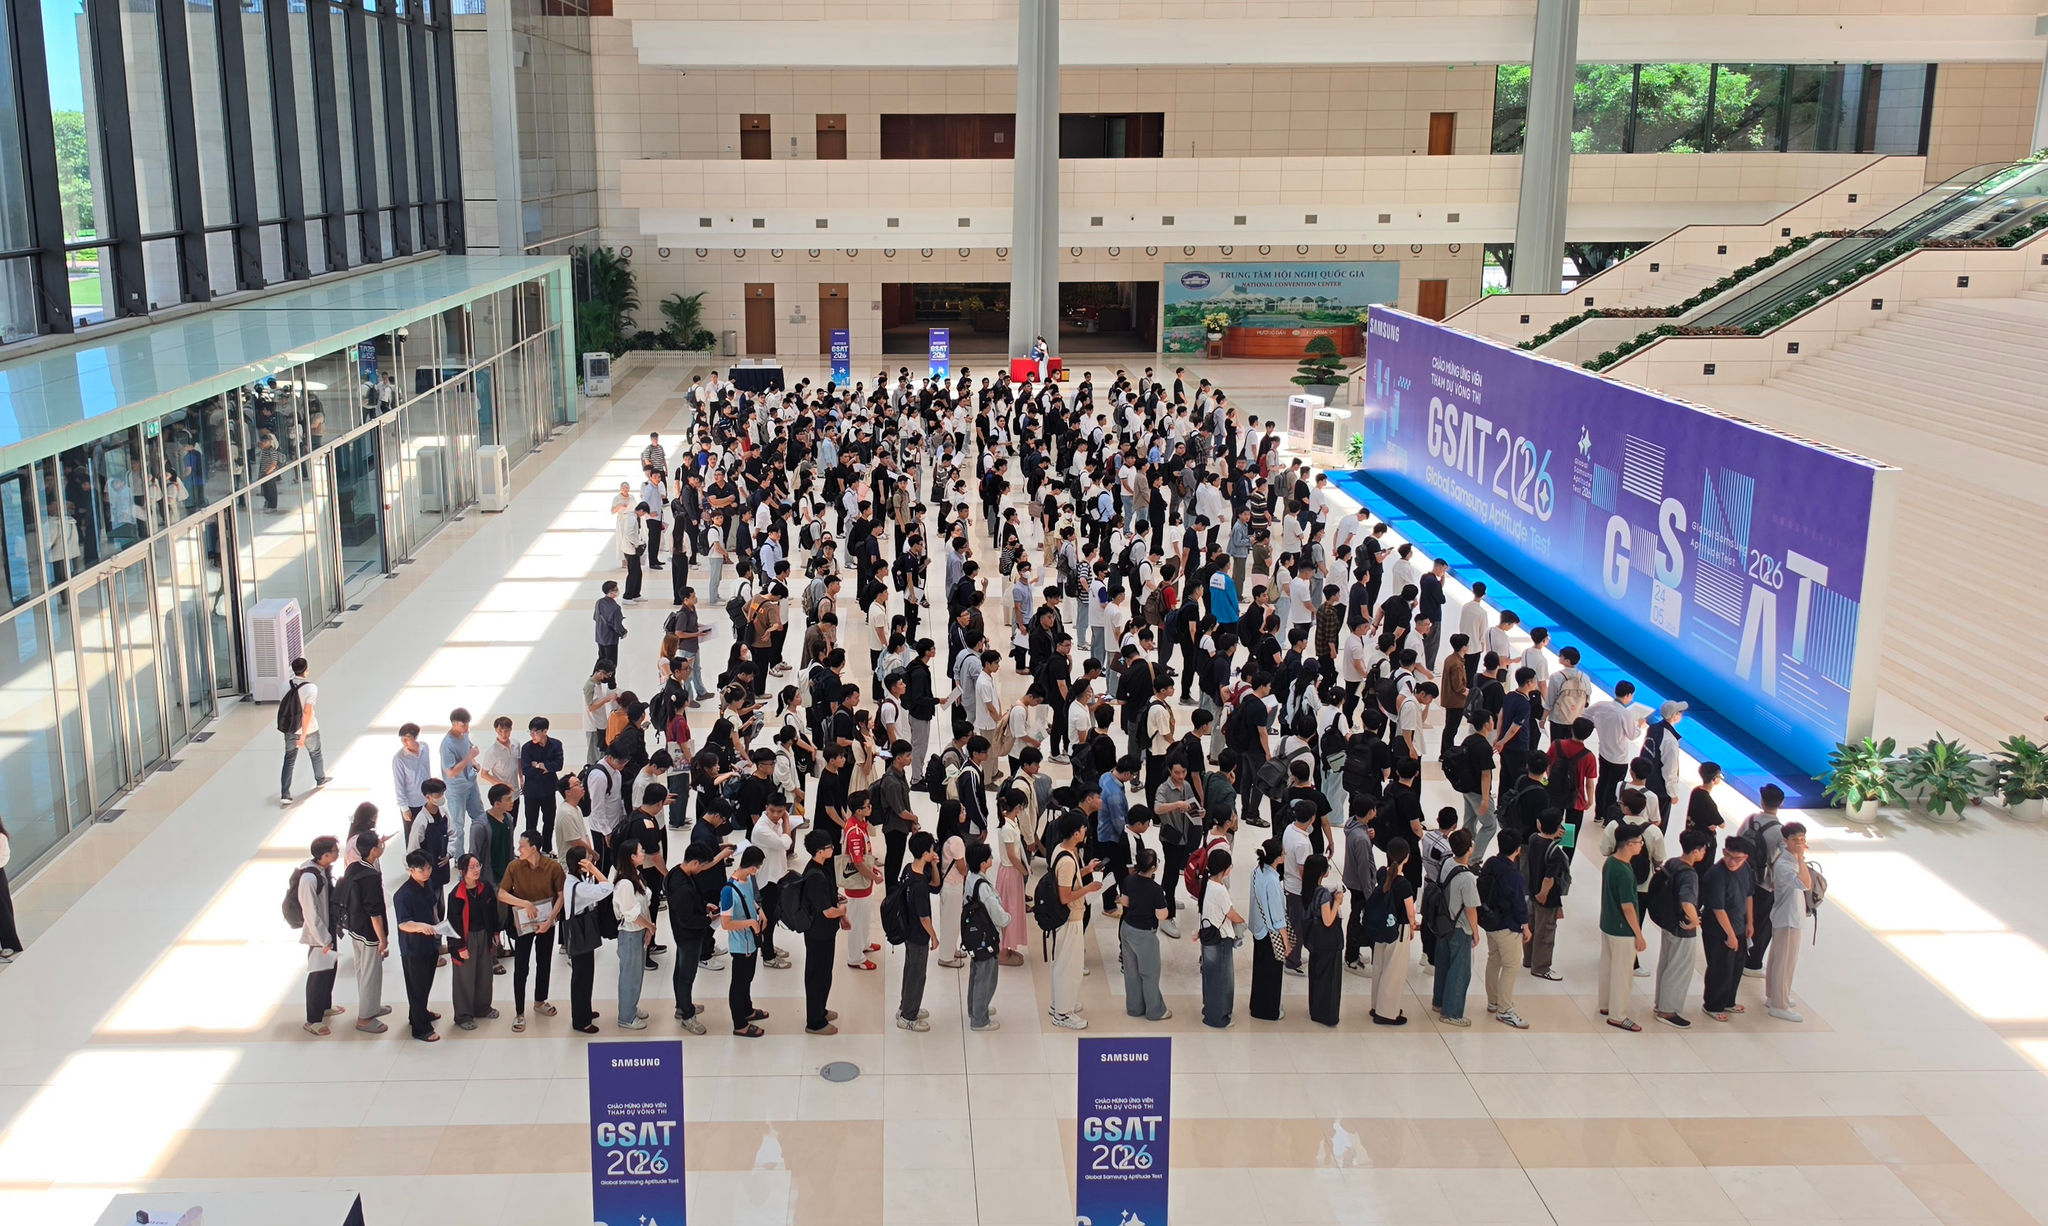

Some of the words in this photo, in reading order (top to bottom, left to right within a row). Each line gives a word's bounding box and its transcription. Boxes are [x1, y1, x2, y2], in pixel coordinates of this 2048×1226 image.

[1220, 271, 1250, 279] TRUNG
[1253, 270, 1271, 279] TÂM
[1274, 270, 1291, 279] HỘI
[1294, 270, 1318, 279] NGHỊ
[1320, 269, 1347, 279] QUỐC
[1349, 270, 1365, 278] GIA
[1369, 318, 1400, 342] SAMSUNG
[1432, 356, 1445, 372] CHÀO
[1431, 373, 1445, 390] THAM
[1446, 379, 1454, 397] DỰ
[1454, 381, 1471, 400] VÒNG
[1472, 390, 1482, 405] THI
[1428, 396, 1493, 486] GSAT
[1492, 427, 1555, 522] 2026
[1425, 465, 1449, 496] Global
[1450, 479, 1489, 524] Samsung
[1488, 503, 1528, 543] Aptitude
[1530, 527, 1551, 556] Test
[1720, 552, 1736, 567] Test
[1748, 549, 1784, 590] 2026
[611, 1058, 660, 1067] SAMSUNG
[1100, 1053, 1149, 1062] SAMSUNG
[597, 1121, 677, 1147] GSAT
[1083, 1116, 1163, 1142] GSAT
[607, 1149, 669, 1175] 2026
[1092, 1144, 1153, 1170] 2026
[645, 1178, 667, 1186] Aptitude
[1128, 1173, 1151, 1181] Aptitude
